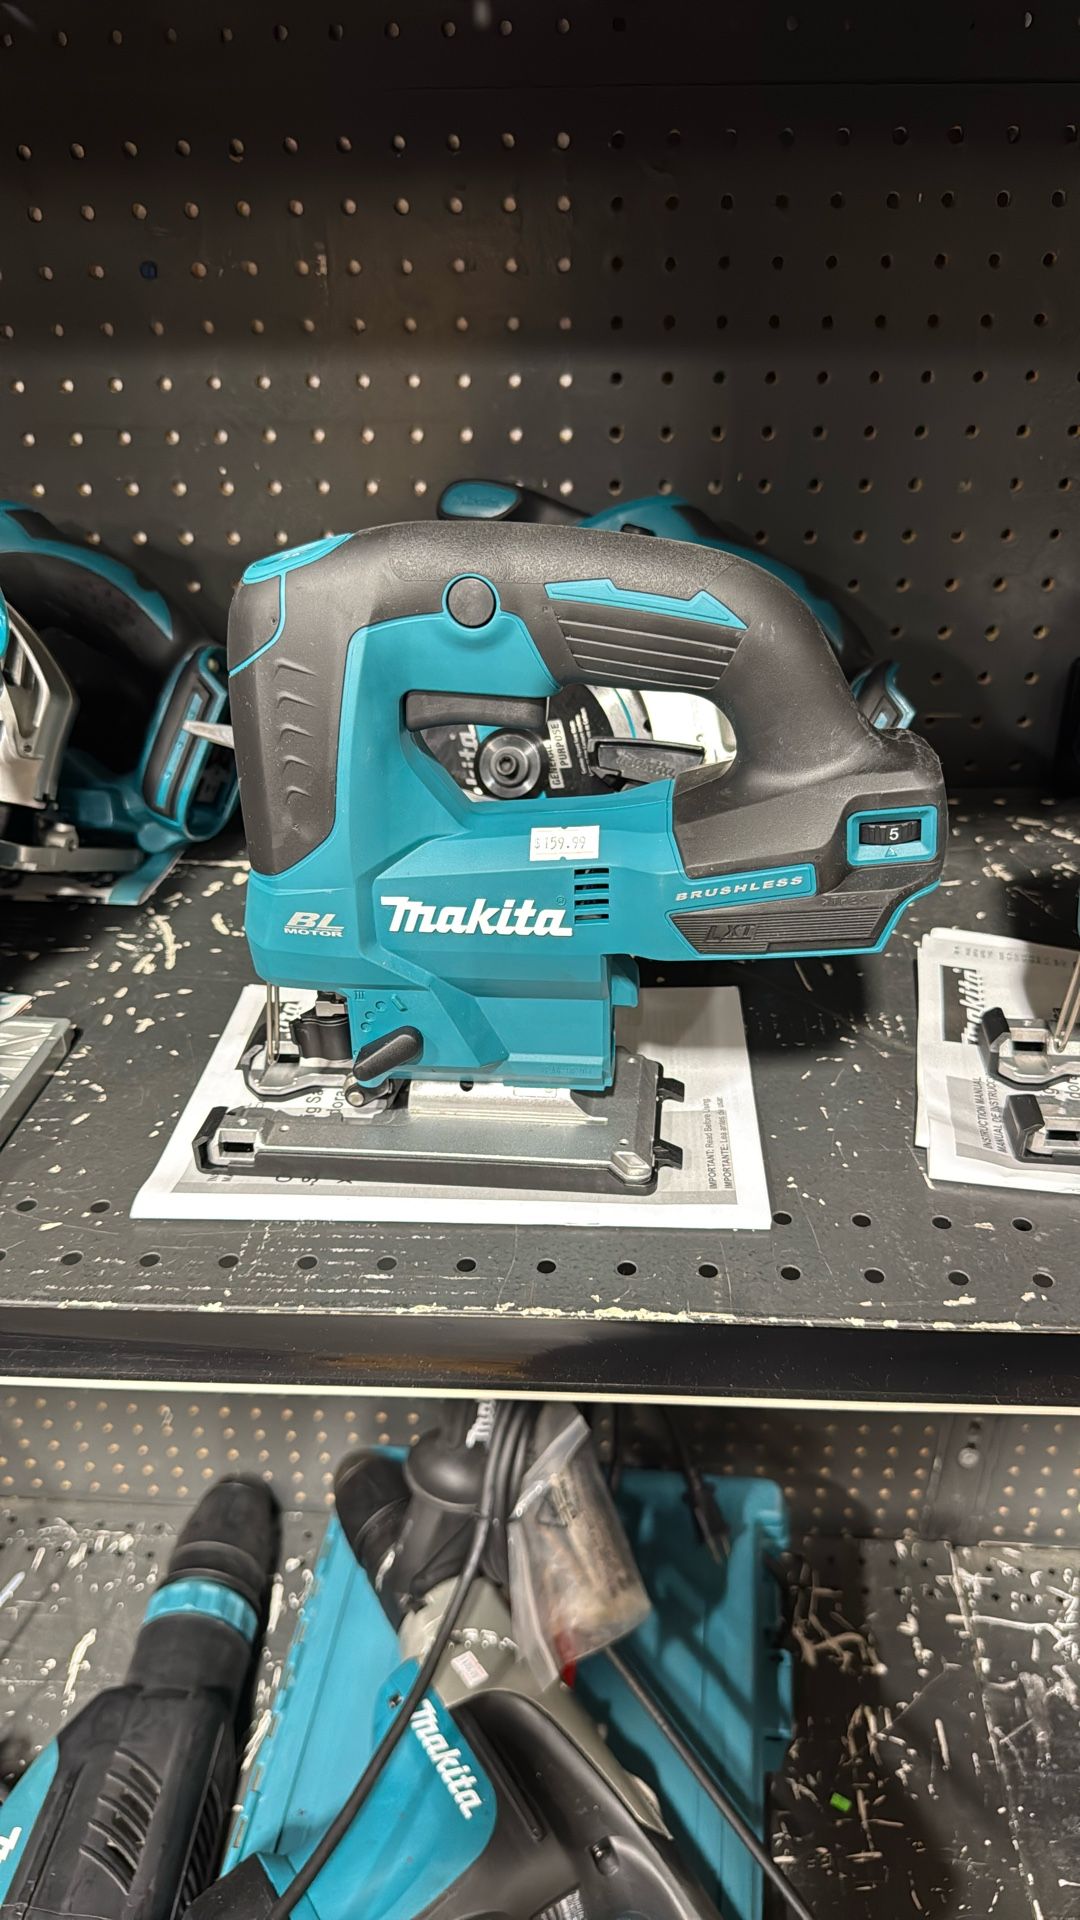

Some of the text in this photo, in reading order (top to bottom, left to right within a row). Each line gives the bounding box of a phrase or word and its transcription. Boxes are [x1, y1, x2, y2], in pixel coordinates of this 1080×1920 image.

[551, 723, 569, 767] PURPOSE
[535, 836, 586, 850] $159.99
[888, 827, 900, 841] 5
[675, 876, 803, 901] BRUSHLESS
[286, 911, 345, 930] BL
[380, 896, 573, 937] makita
[283, 927, 344, 938] MOTOR
[705, 924, 756, 942] LXT
[703, 1114, 713, 1132] Before
[972, 1077, 993, 1149] INSTRUCTION MANUAL
[704, 1133, 714, 1148] Read
[720, 1132, 729, 1143] Lea
[992, 1125, 1007, 1153] MANUAL
[706, 1150, 718, 1189] IMPORTANT:
[720, 1143, 733, 1189] IMPORTANTE:
[410, 1699, 484, 1820] makita
